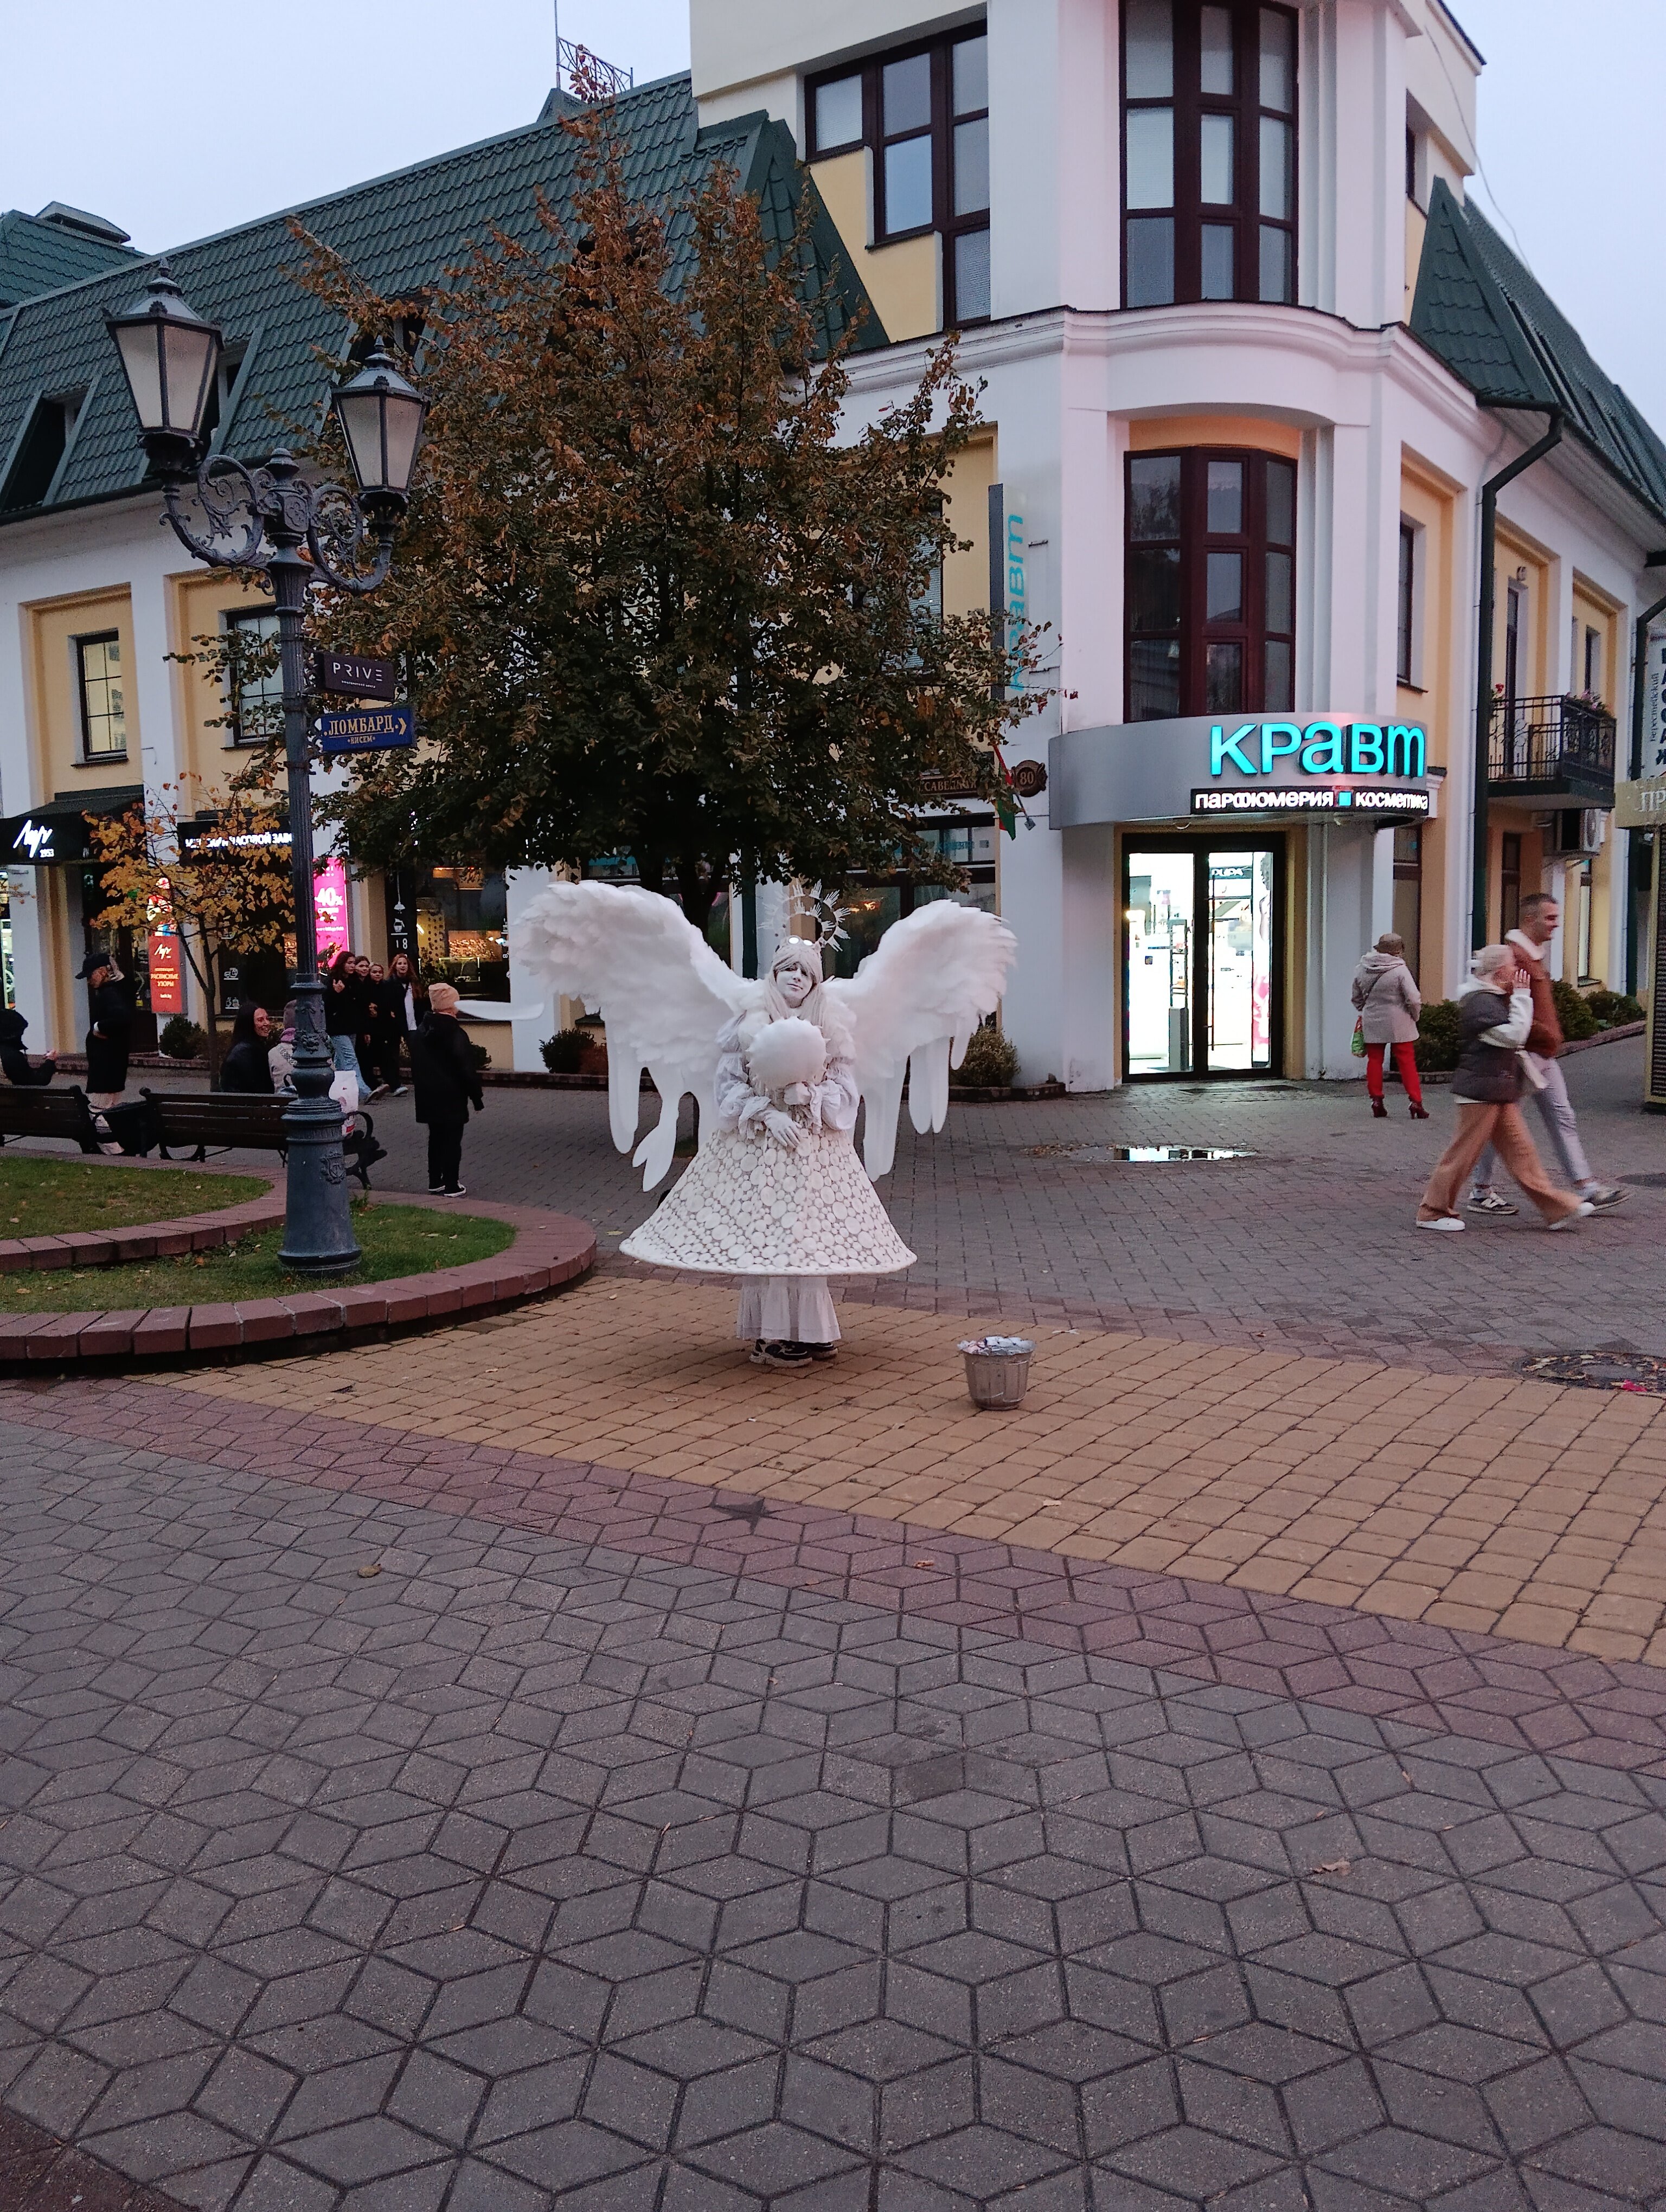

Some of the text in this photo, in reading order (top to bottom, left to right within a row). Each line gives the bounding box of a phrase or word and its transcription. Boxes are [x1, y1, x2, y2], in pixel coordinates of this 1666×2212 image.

[333, 662, 382, 681] PRIVE
[328, 715, 394, 735] ЛОМБАРД
[1019, 771, 1034, 785] 80
[13, 820, 53, 858] Луч
[1212, 868, 1244, 877] PUPA
